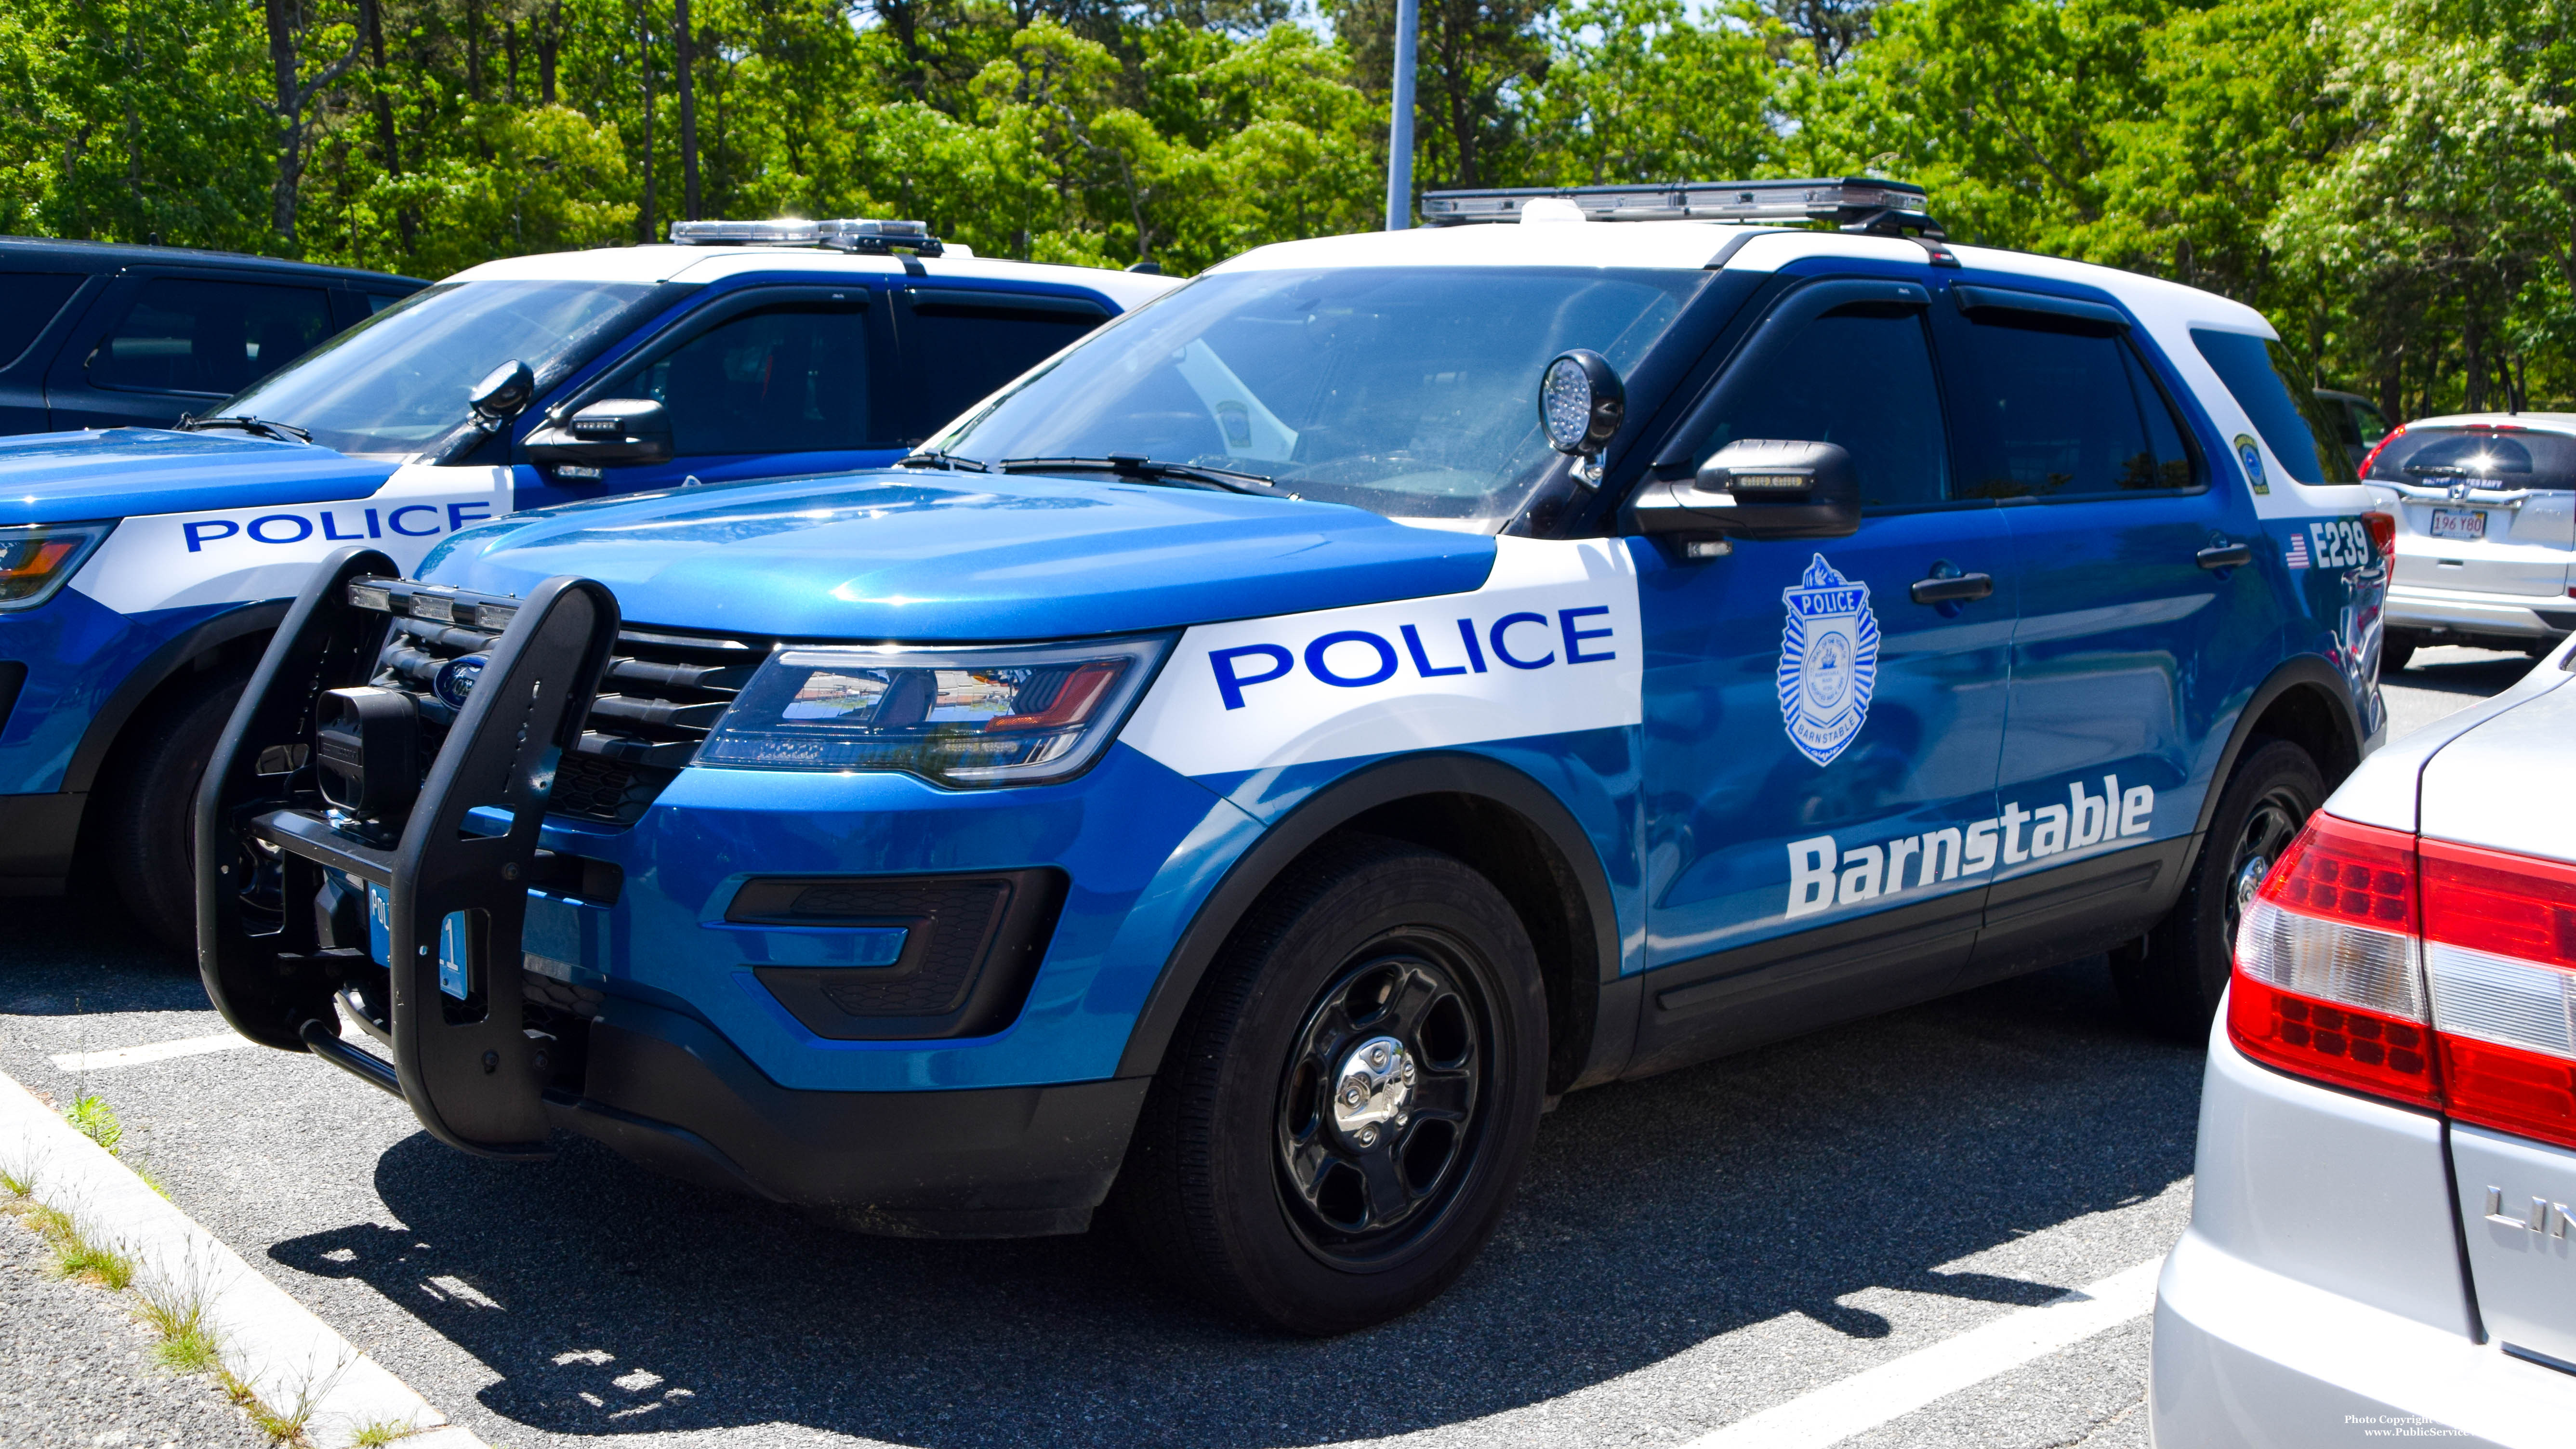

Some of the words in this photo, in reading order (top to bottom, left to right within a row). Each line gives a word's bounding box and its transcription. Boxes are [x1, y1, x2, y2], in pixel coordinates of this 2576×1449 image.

[183, 501, 491, 553] POLICE
[2310, 521, 2369, 568] E239
[2434, 516, 2456, 530] 196
[2460, 517, 2482, 531] Y80
[1801, 592, 1855, 614] POLICE
[1208, 606, 1616, 711] POLICE
[1798, 718, 1855, 744] BARNSTABLE
[1785, 774, 2154, 920] Barnstable
